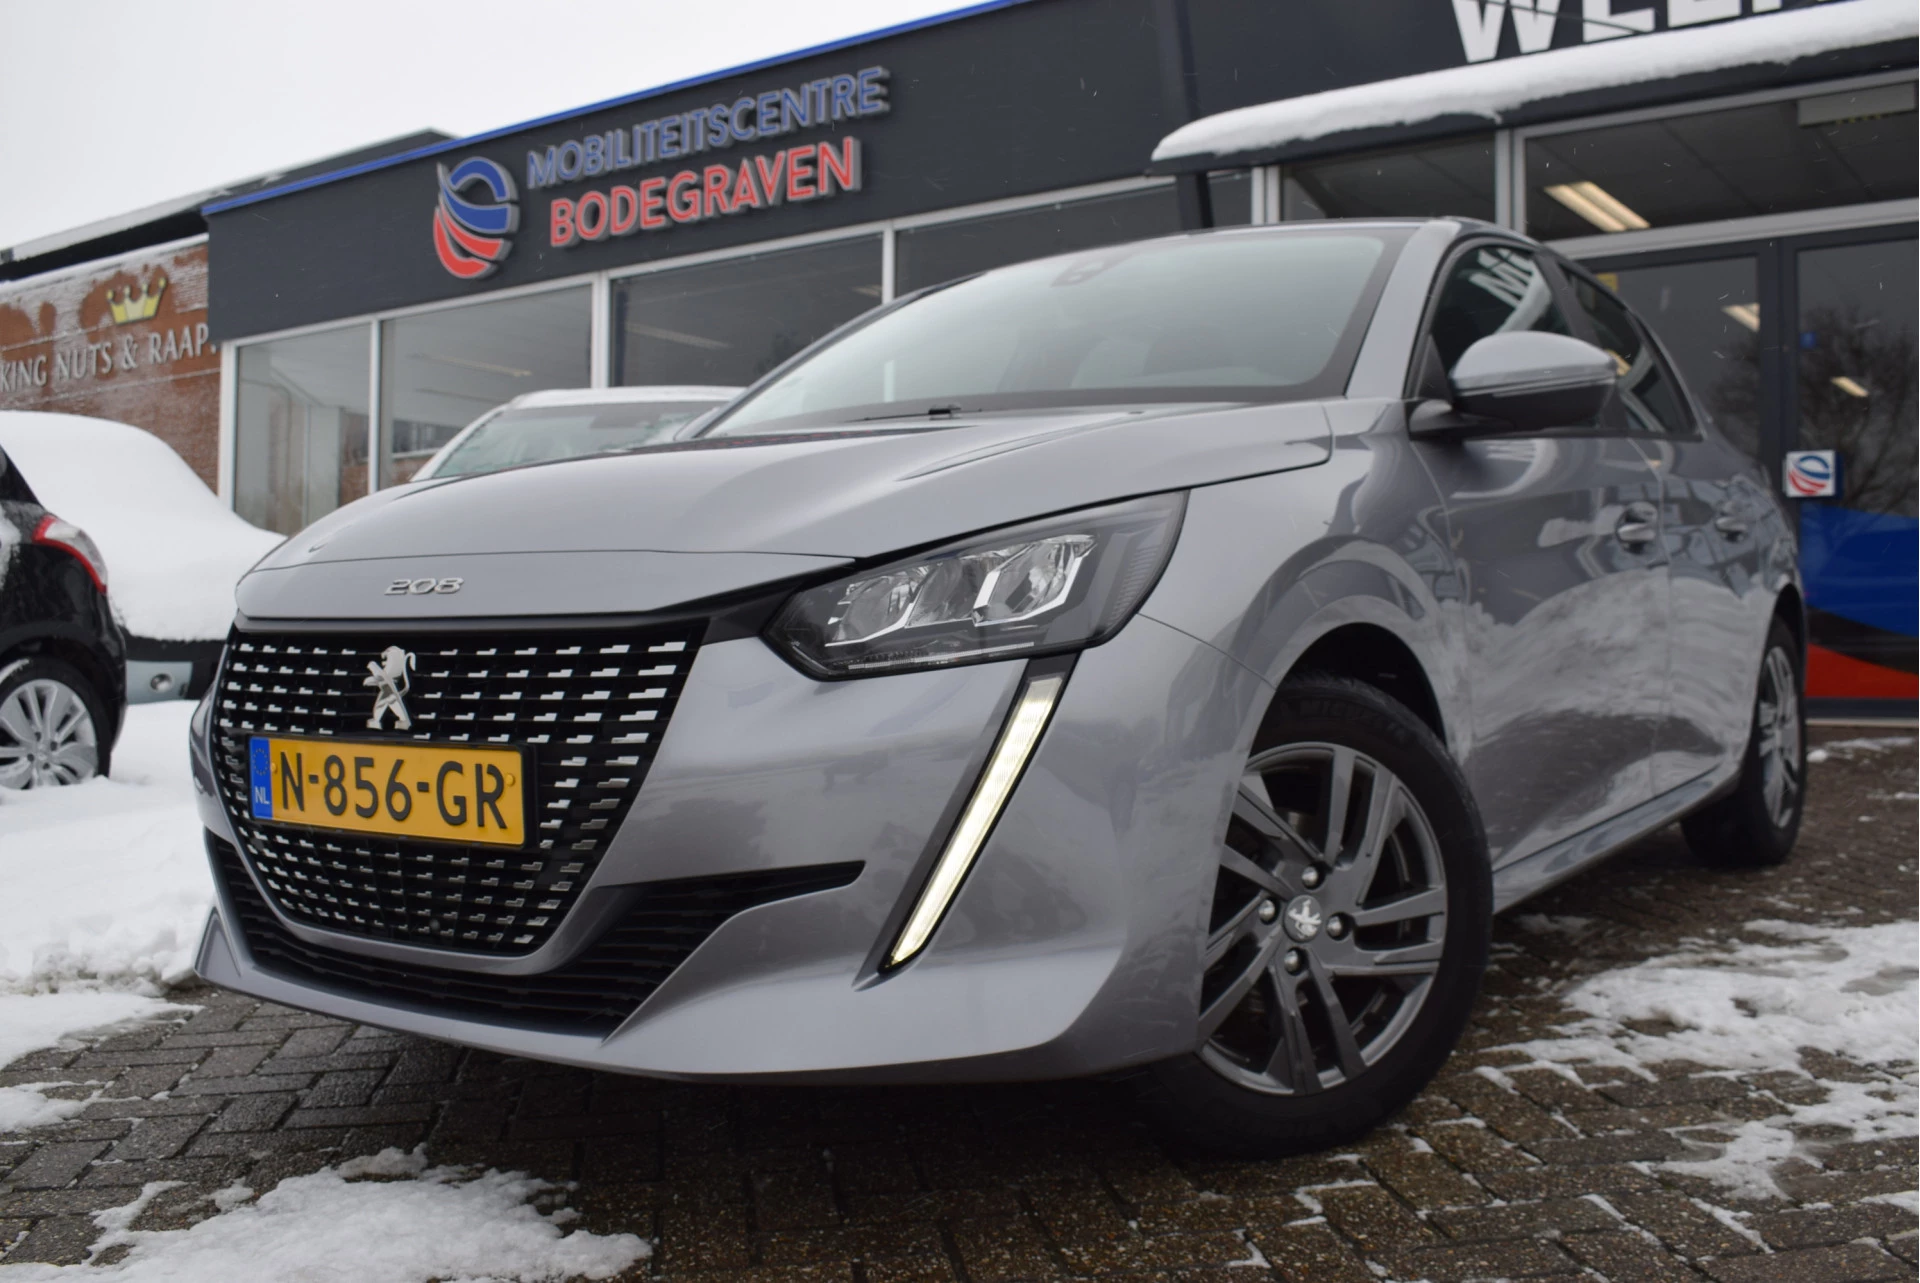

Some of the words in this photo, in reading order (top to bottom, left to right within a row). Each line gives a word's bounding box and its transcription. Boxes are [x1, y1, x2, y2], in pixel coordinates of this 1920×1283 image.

[527, 66, 890, 188] MOBILITEITSCENTRE
[550, 137, 861, 247] BODEGRAVEN
[0, 355, 47, 391] KING
[56, 341, 113, 380] NUTS
[121, 333, 138, 370] &
[149, 322, 217, 364] RAAP
[384, 577, 464, 595] 208
[254, 786, 270, 805] NL
[279, 751, 508, 829] N-856-GR
